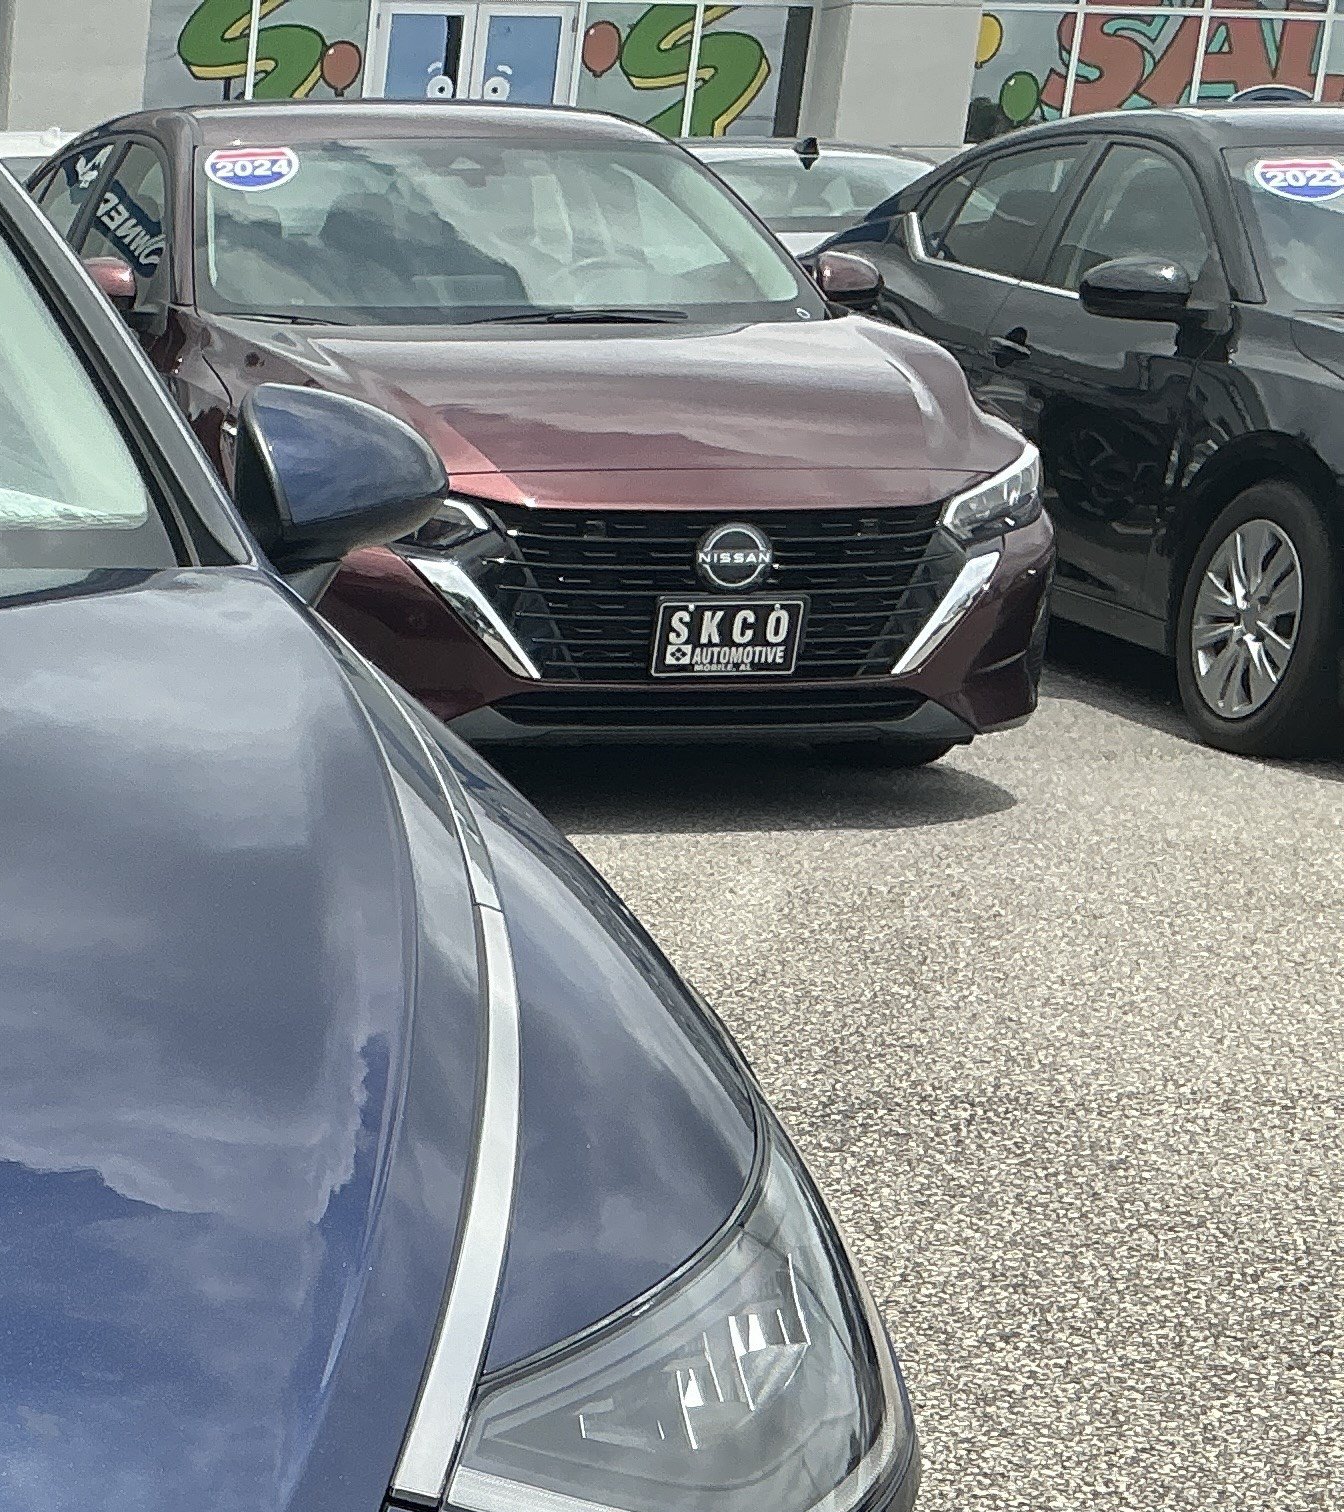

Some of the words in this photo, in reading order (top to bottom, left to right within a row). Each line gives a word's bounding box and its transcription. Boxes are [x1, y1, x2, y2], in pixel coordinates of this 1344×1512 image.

[215, 159, 290, 177] 2024
[698, 552, 770, 564] NISSAN
[692, 646, 786, 664] AUTOMOTIVE
